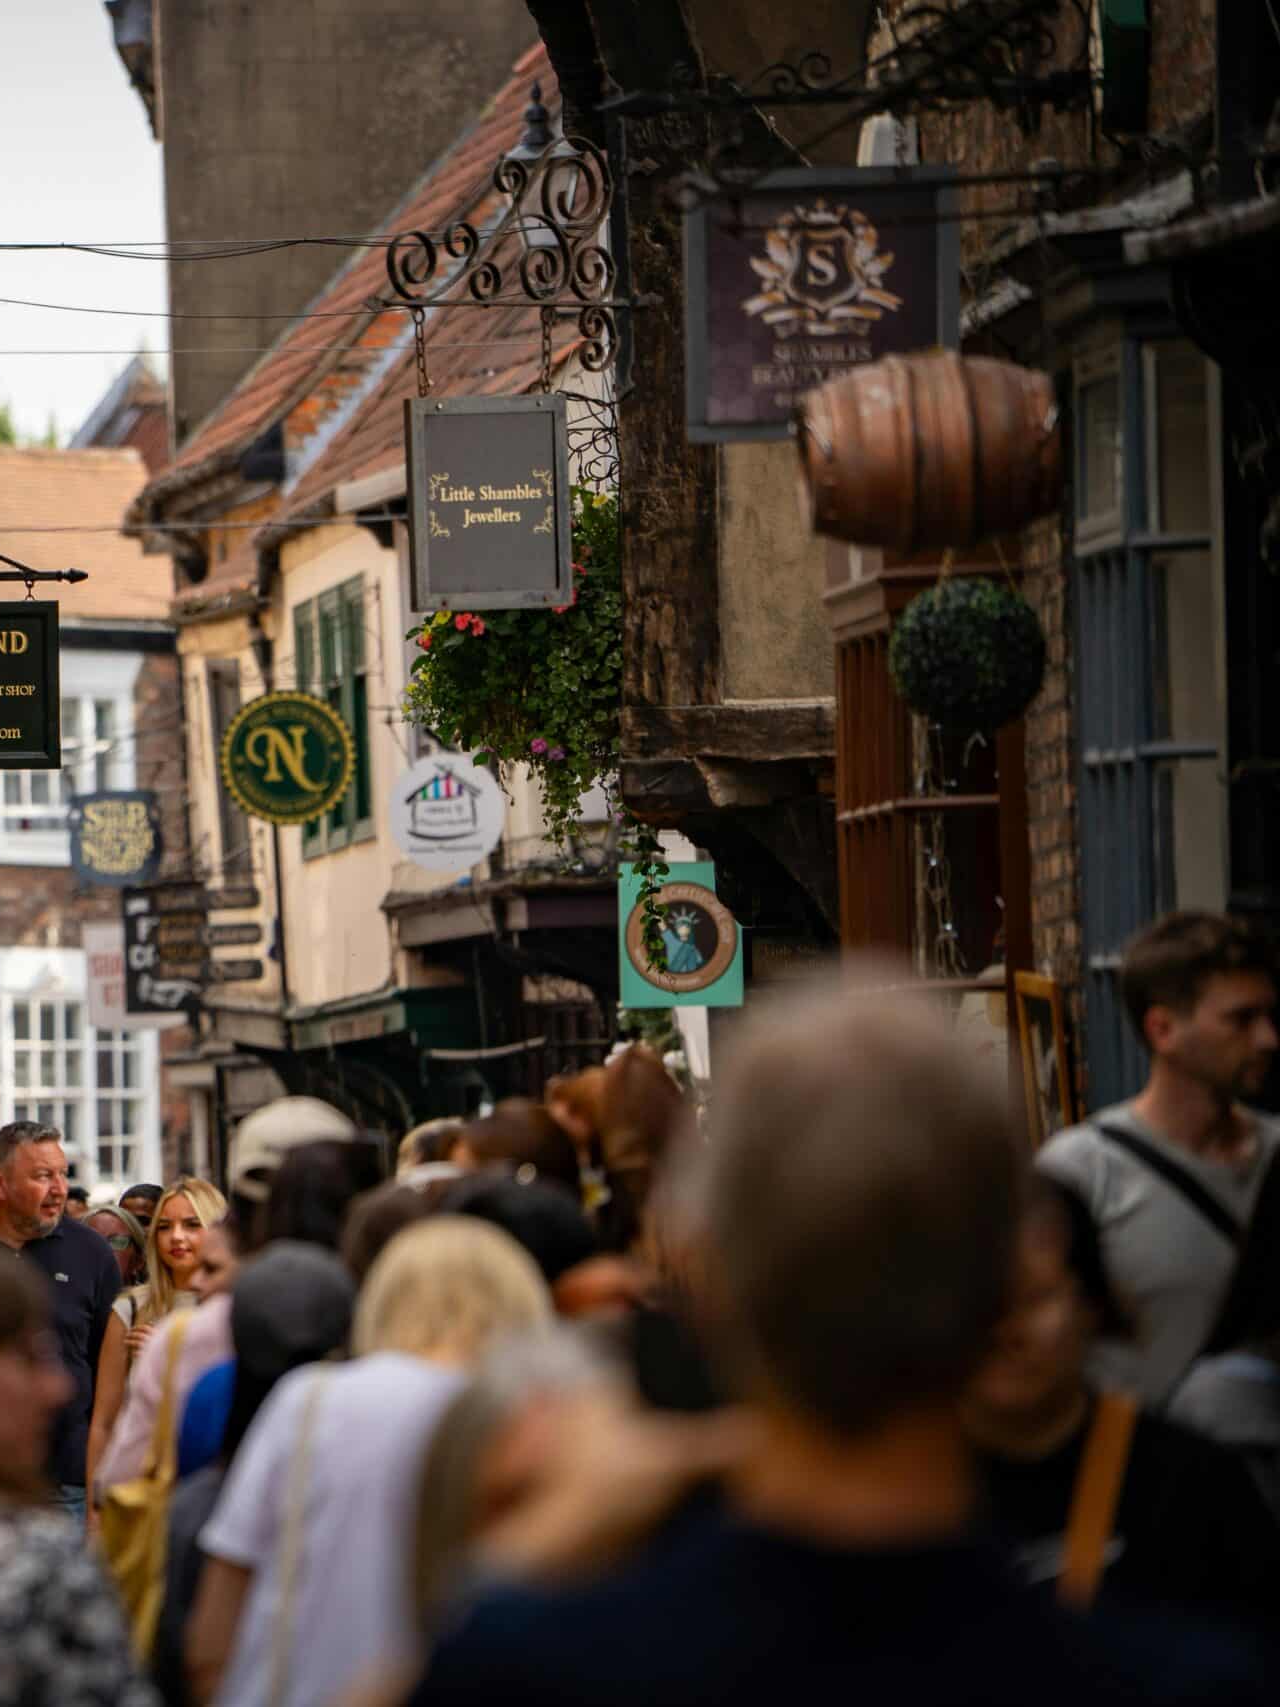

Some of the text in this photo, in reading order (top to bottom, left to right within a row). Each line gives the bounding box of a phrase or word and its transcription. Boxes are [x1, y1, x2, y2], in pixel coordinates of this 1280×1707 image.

[441, 483, 542, 502] Little Shambles
[463, 506, 520, 528] Jewellers
[6, 684, 36, 696] SHOP
